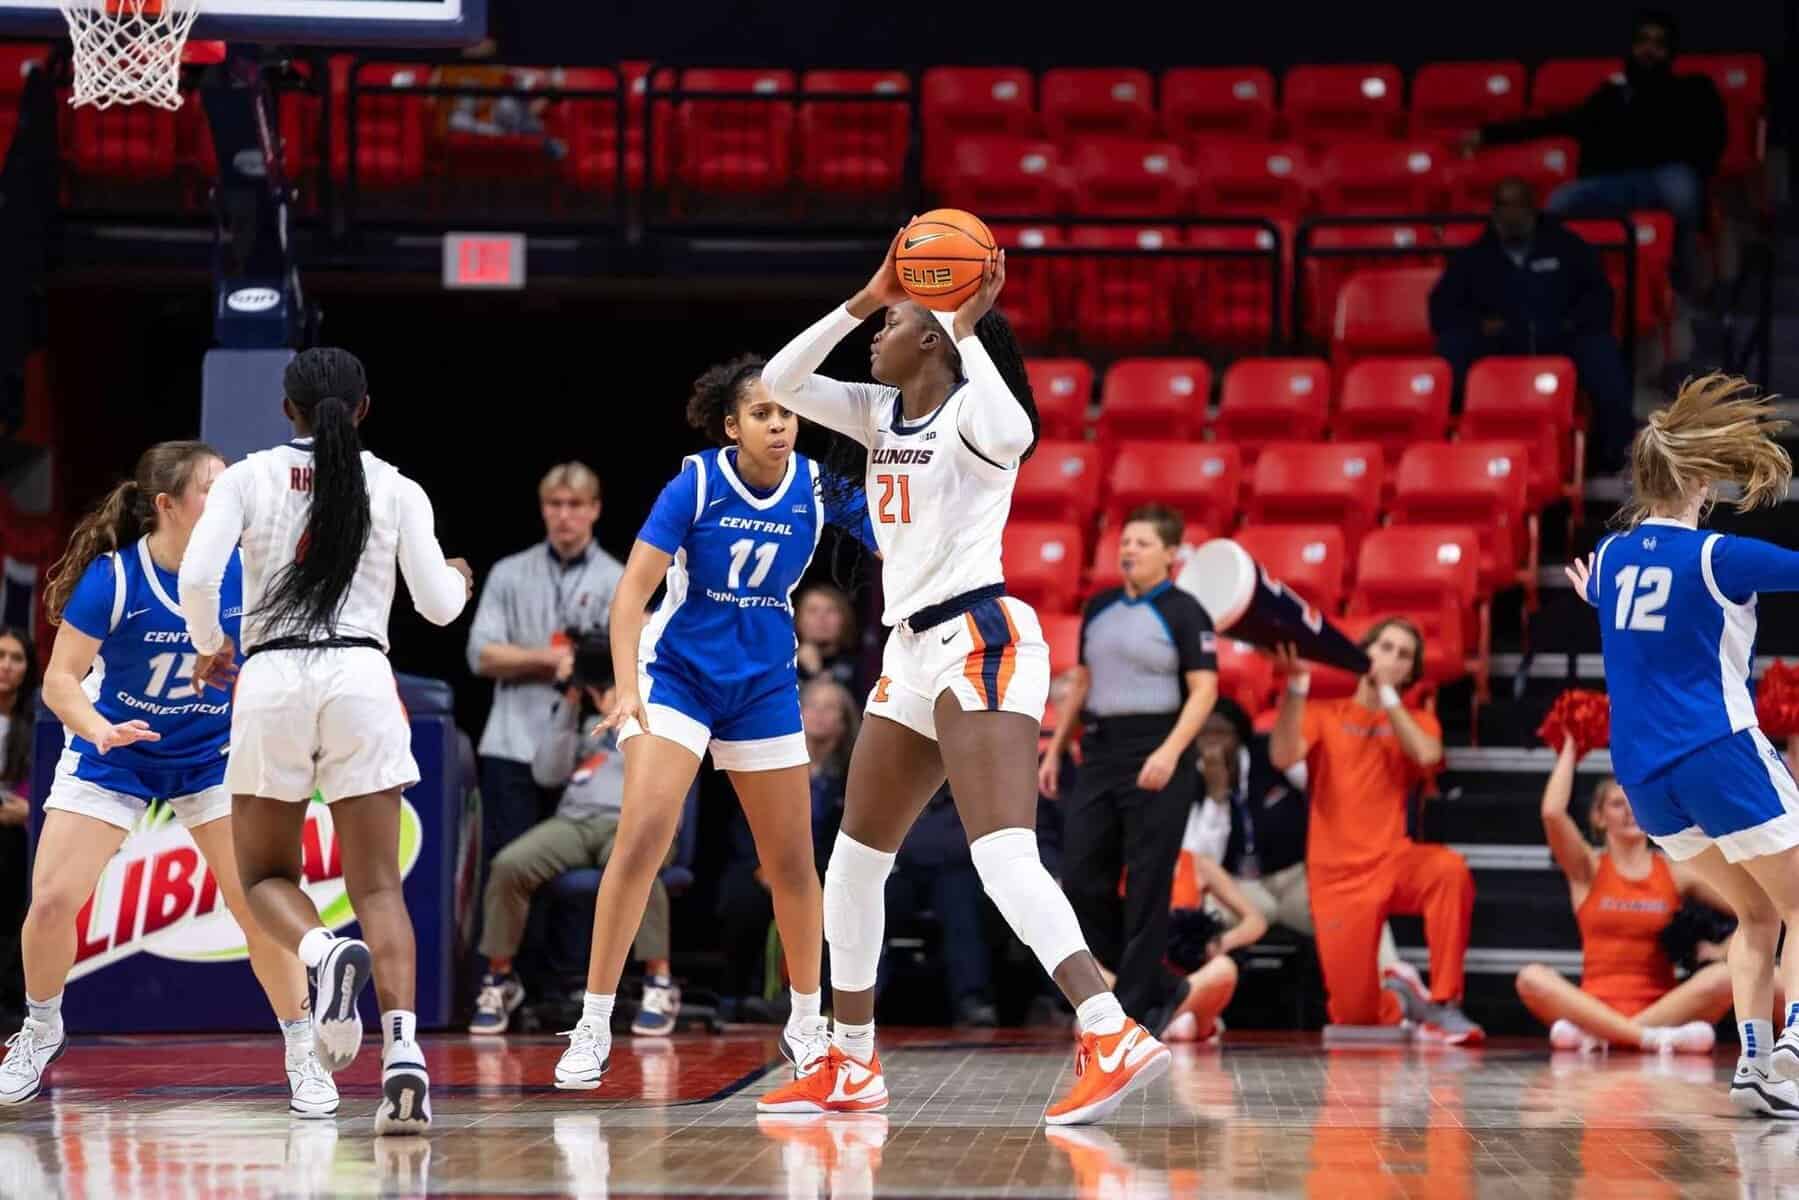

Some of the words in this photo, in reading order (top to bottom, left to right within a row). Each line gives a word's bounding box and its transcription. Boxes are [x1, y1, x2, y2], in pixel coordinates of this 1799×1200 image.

[876, 474, 912, 523] 21
[719, 516, 793, 536] CENTRAL
[727, 539, 780, 589] 11
[1615, 564, 1673, 632] 12
[143, 631, 193, 644] CENT
[144, 652, 207, 700] 15
[116, 690, 230, 716] CONNECTICUT
